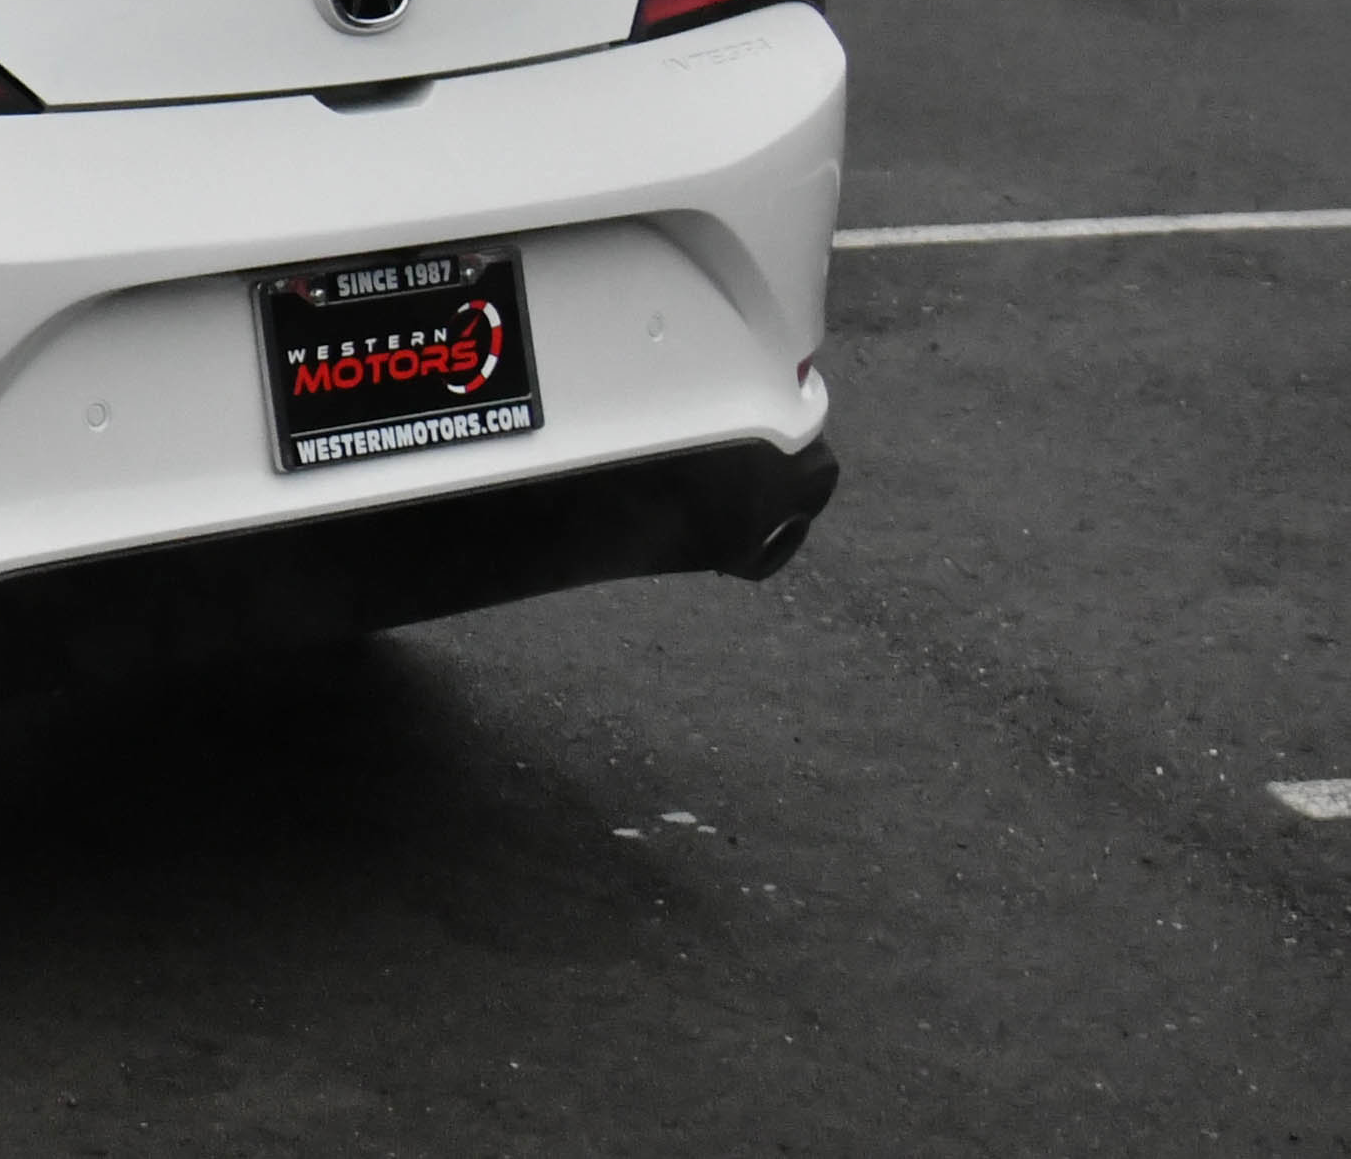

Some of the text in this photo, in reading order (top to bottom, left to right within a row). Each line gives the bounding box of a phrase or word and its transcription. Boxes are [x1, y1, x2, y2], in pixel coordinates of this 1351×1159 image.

[337, 259, 453, 297] SINCE 1987
[287, 328, 448, 365] WESTERN
[293, 340, 478, 396] MOTORS
[297, 404, 531, 464] WESTERNMOTORS.COM
